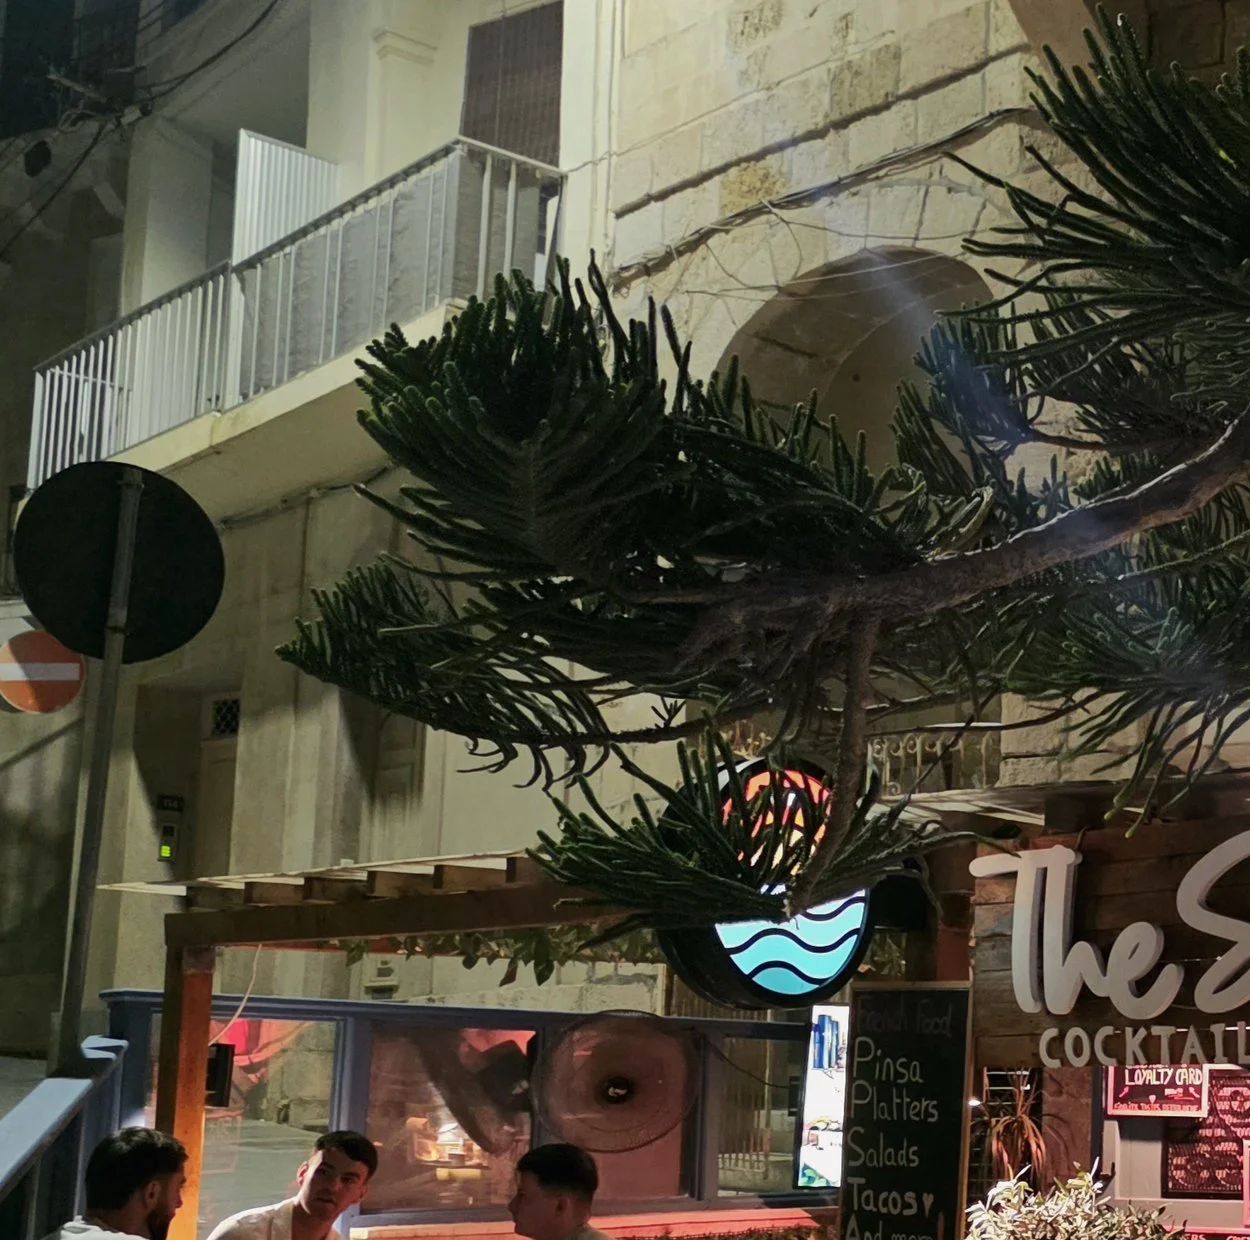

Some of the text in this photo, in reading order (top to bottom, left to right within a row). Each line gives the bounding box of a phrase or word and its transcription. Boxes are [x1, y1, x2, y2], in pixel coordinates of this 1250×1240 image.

[969, 845, 1184, 1020] The
[853, 1036, 924, 1084] Pinsa
[1125, 1068, 1202, 1086] LOYALTY CARD
[850, 1079, 939, 1123] Platters
[847, 1126, 920, 1169] Salads
[847, 1177, 918, 1217] Tacos
